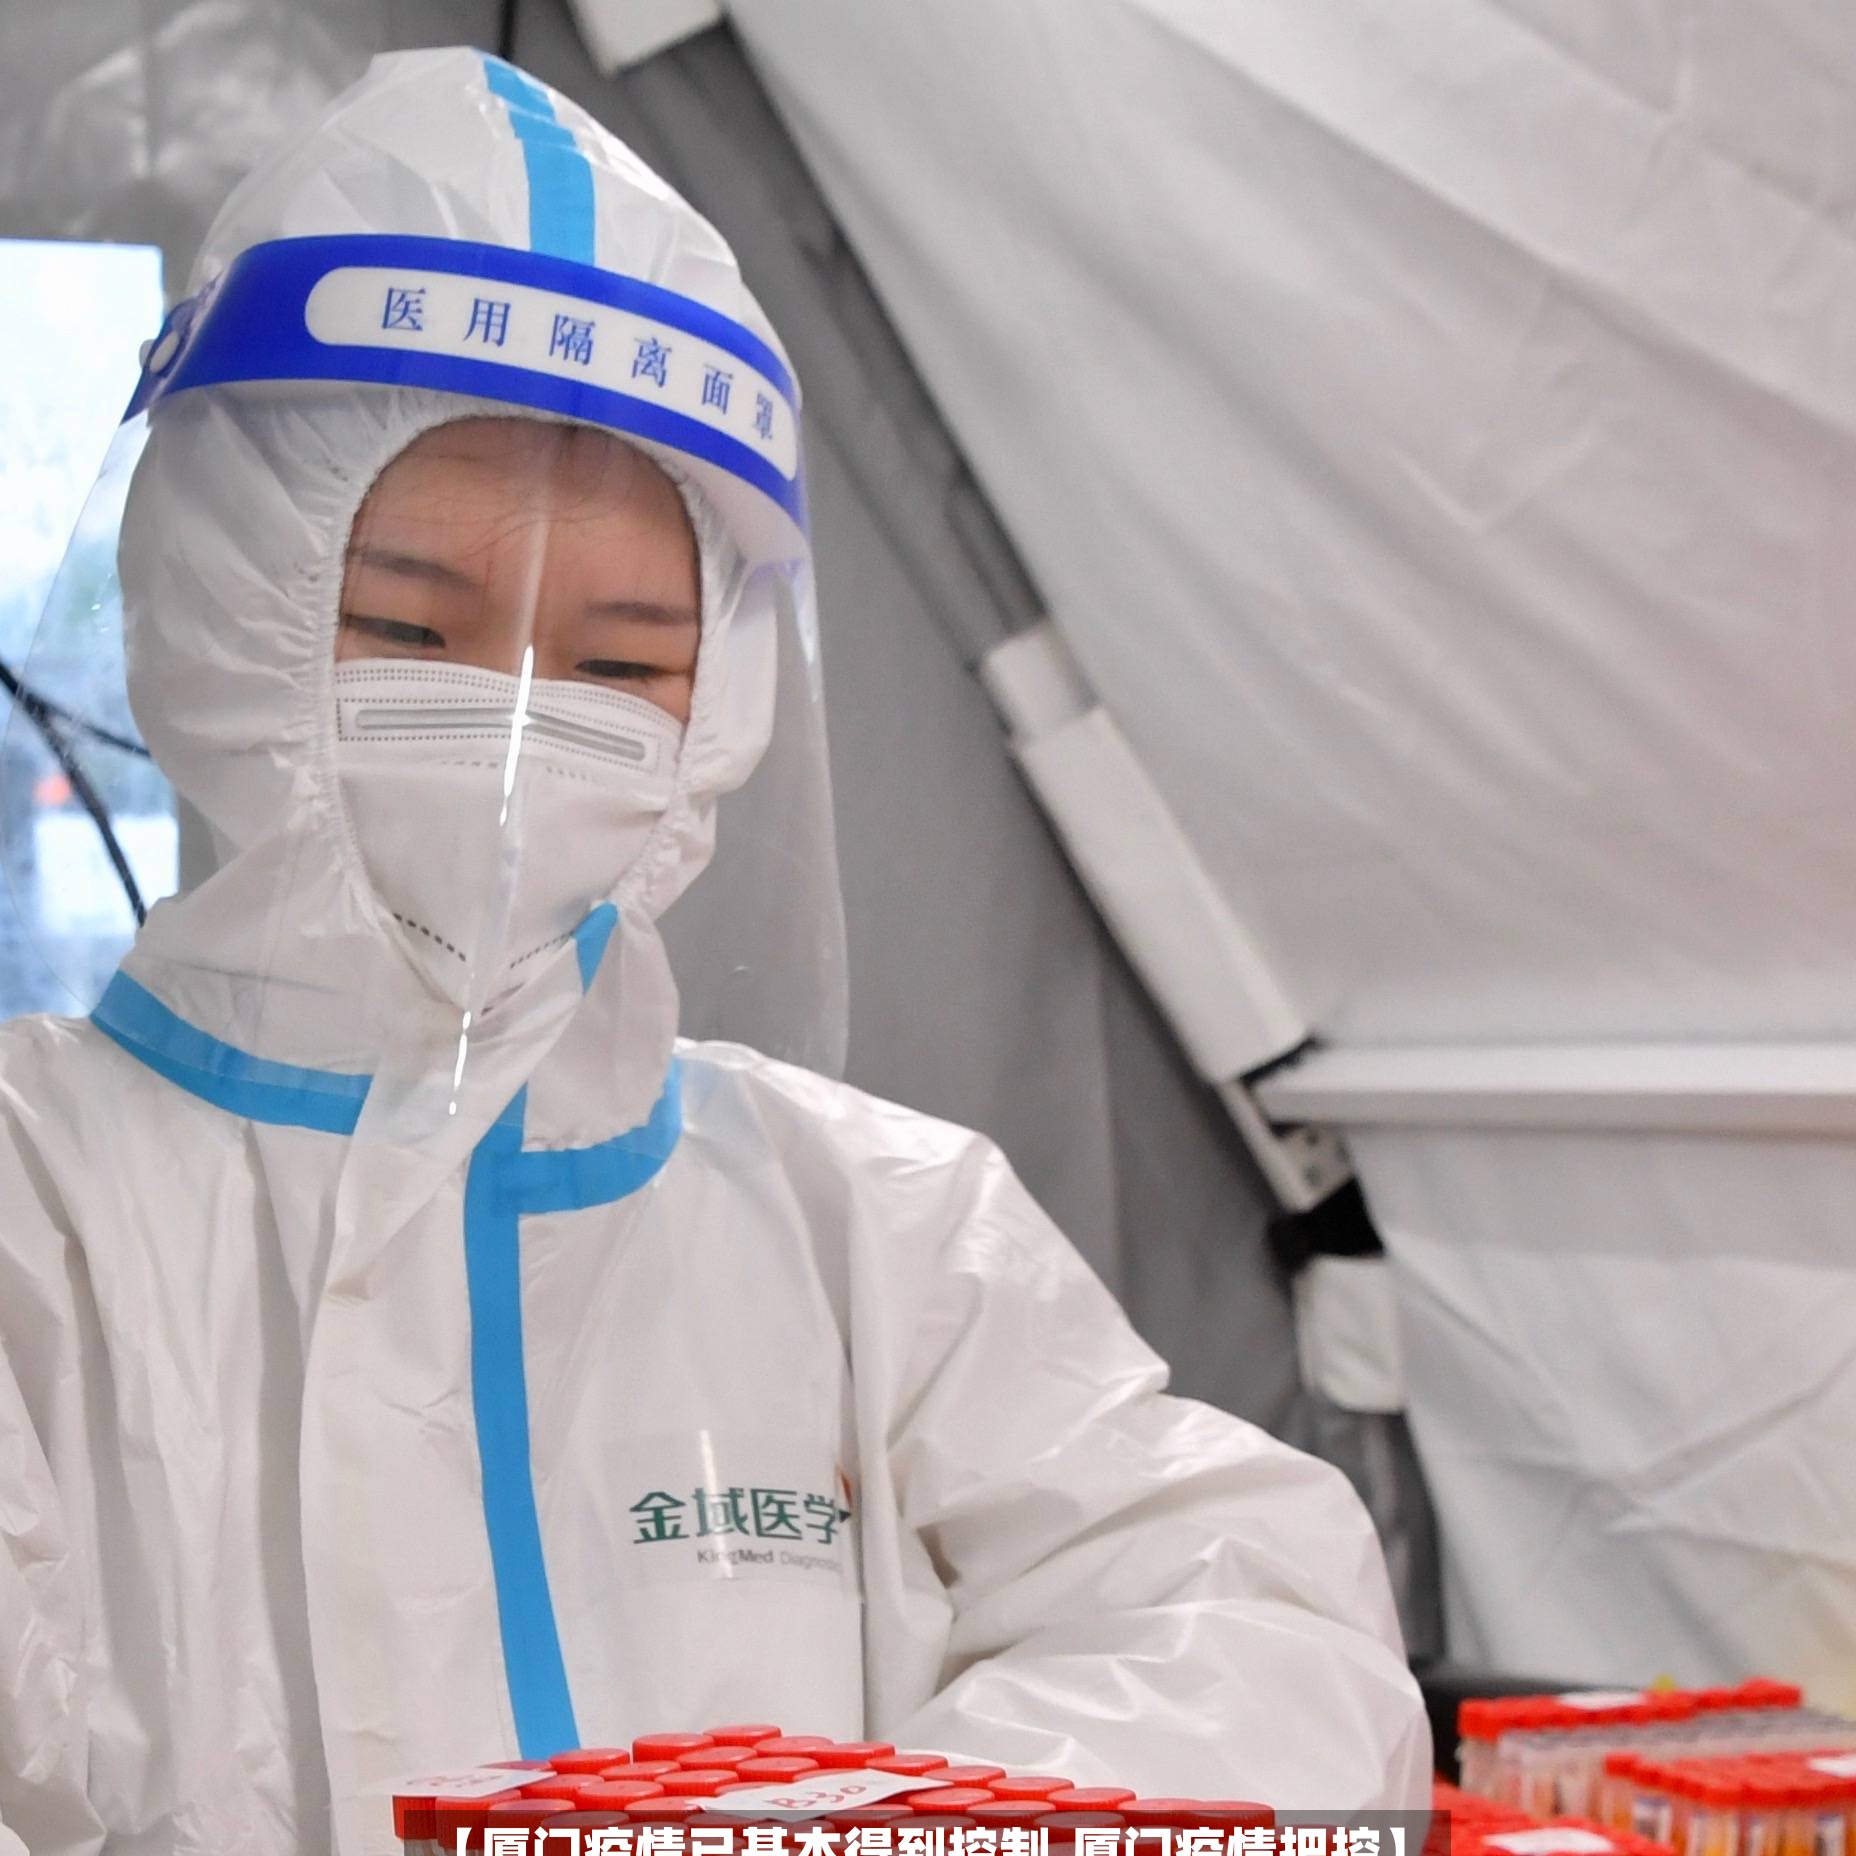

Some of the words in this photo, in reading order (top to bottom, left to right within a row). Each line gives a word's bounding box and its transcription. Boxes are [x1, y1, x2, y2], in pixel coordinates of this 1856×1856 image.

[380, 287, 773, 441] 医用隔离面罩
[629, 1487, 841, 1545] 金域医学
